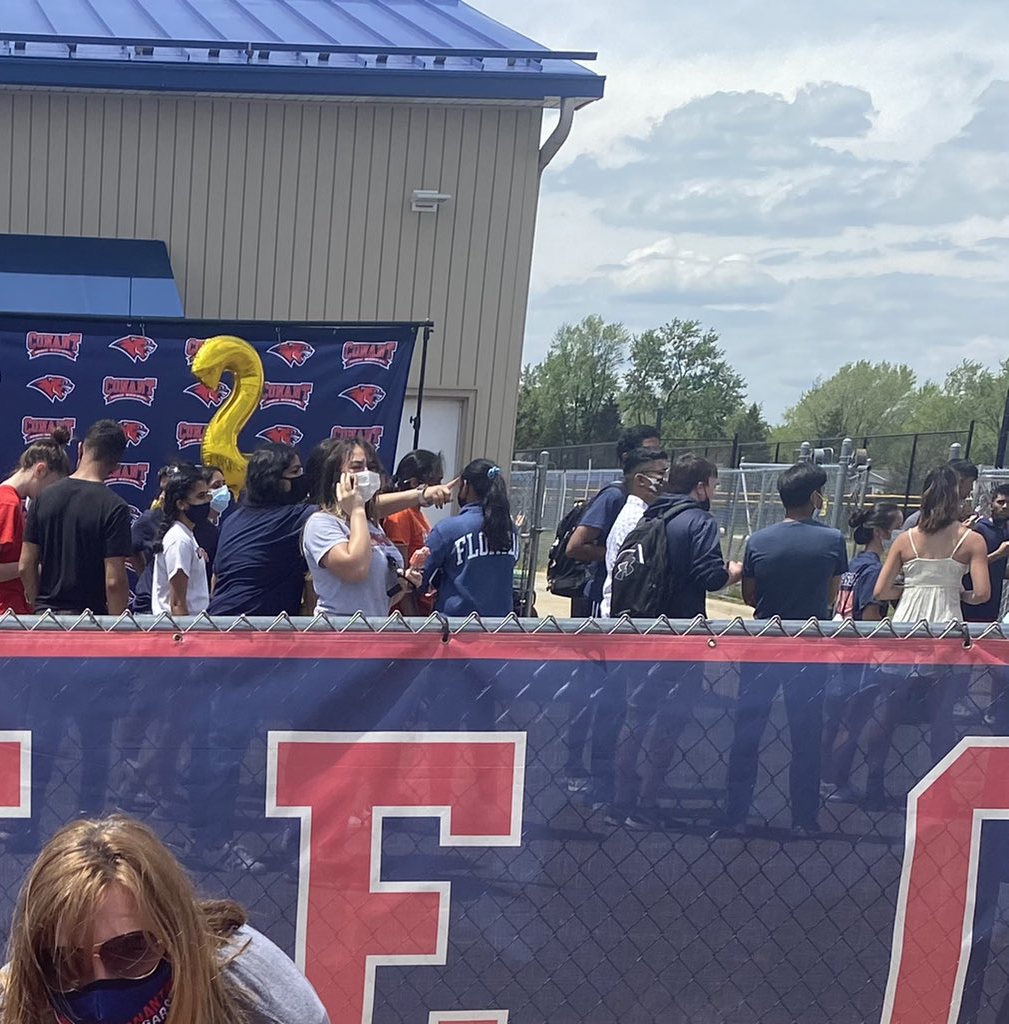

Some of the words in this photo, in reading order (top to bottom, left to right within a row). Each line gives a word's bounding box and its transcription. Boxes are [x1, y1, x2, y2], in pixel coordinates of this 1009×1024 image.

[26, 331, 82, 351] CONANT
[342, 341, 398, 360] CONANT
[102, 376, 158, 397] CONANT
